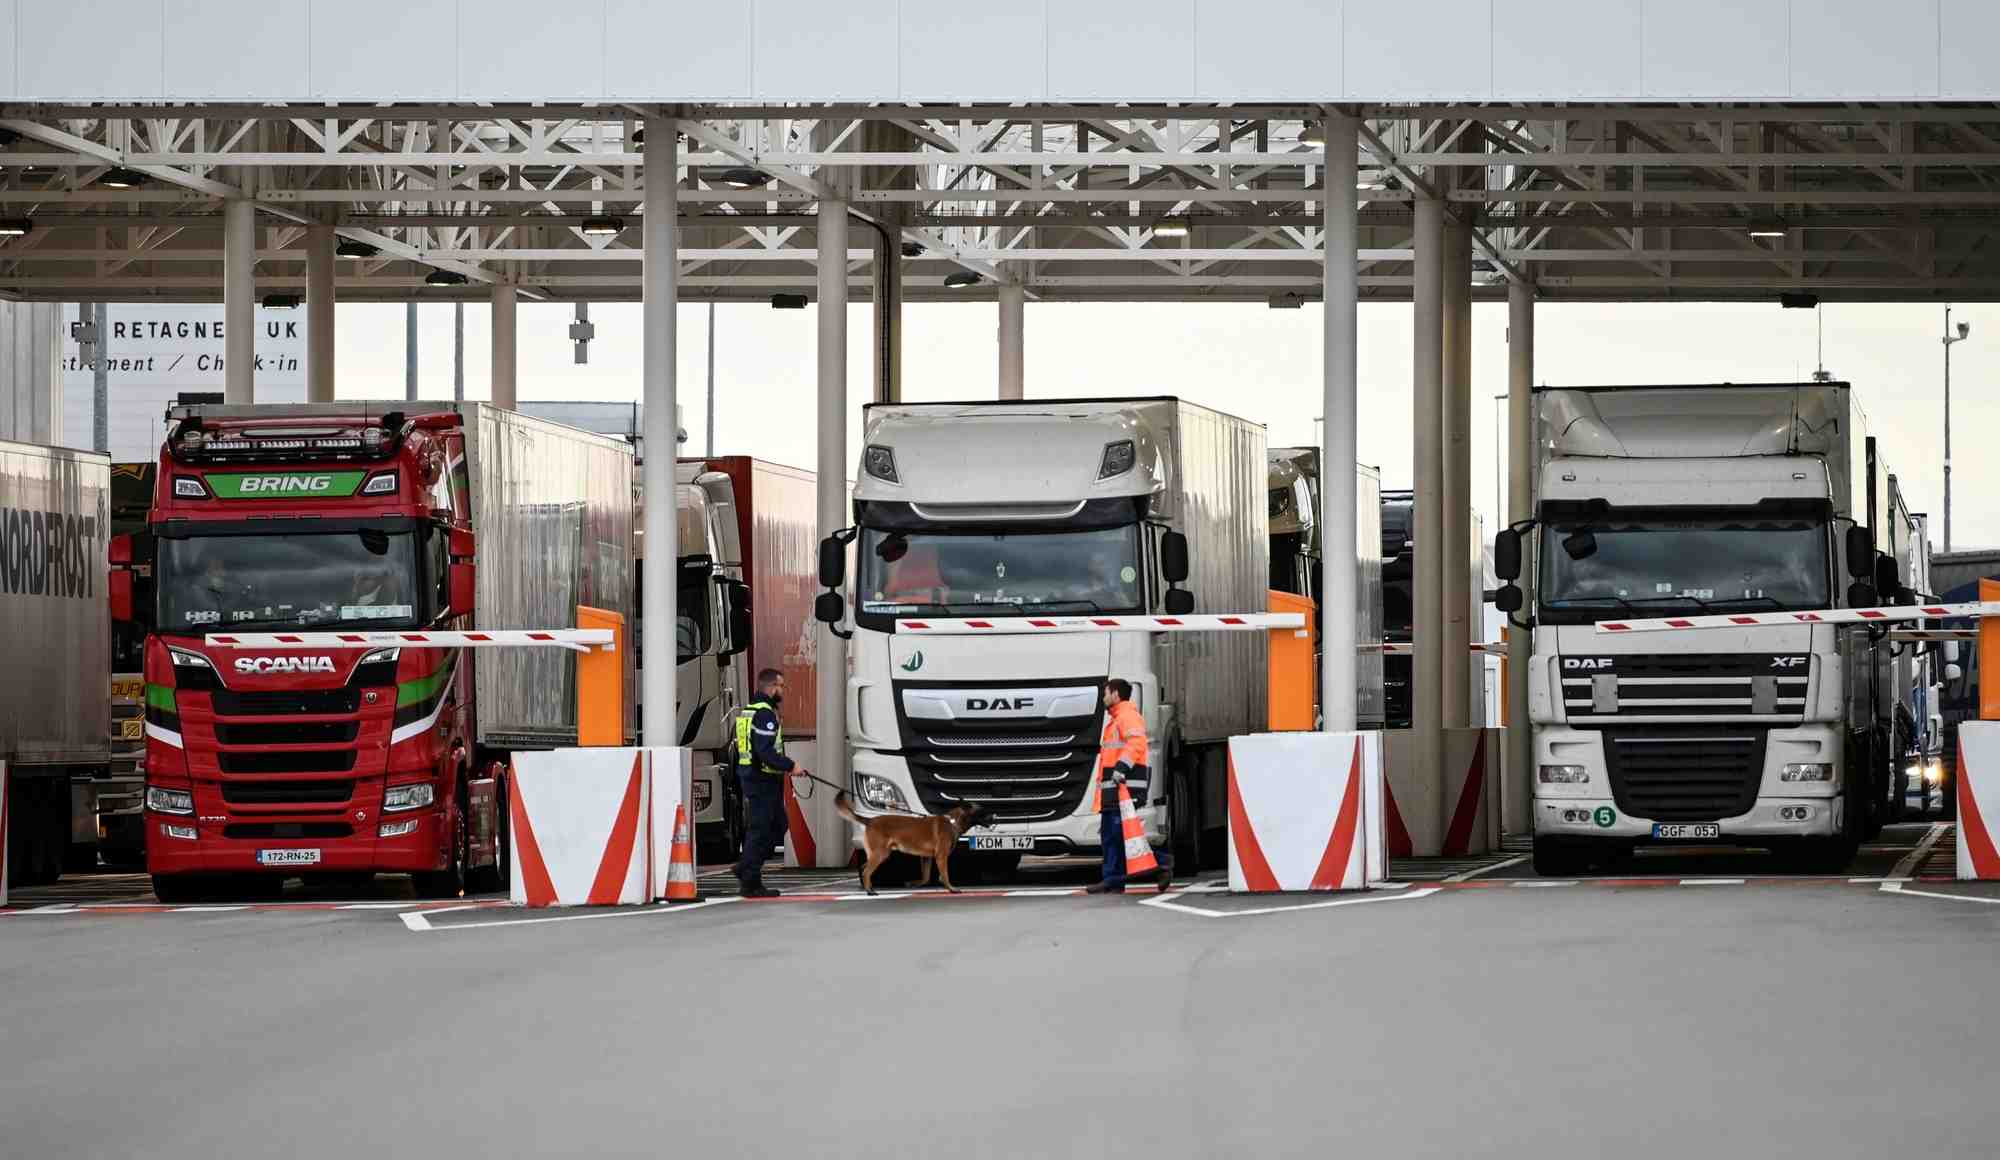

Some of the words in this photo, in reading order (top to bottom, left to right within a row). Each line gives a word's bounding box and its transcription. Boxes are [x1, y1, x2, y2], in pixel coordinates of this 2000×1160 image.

[114, 321, 224, 339] RETAGNE
[267, 321, 298, 338] UK
[197, 354, 297, 371] Chk-in
[239, 476, 331, 492] BRING
[0, 507, 95, 598] NORDFROST
[234, 656, 336, 673] SCANIA
[1564, 658, 1613, 668] DAF
[1770, 656, 1807, 667] XF
[966, 697, 1034, 711] DAF
[1599, 810, 1610, 824] 5
[1660, 826, 1686, 837] GGF
[1694, 826, 1717, 837] 053
[976, 837, 1003, 849] KDM
[1011, 837, 1032, 848] 147
[266, 851, 316, 862] 172-RN-25
